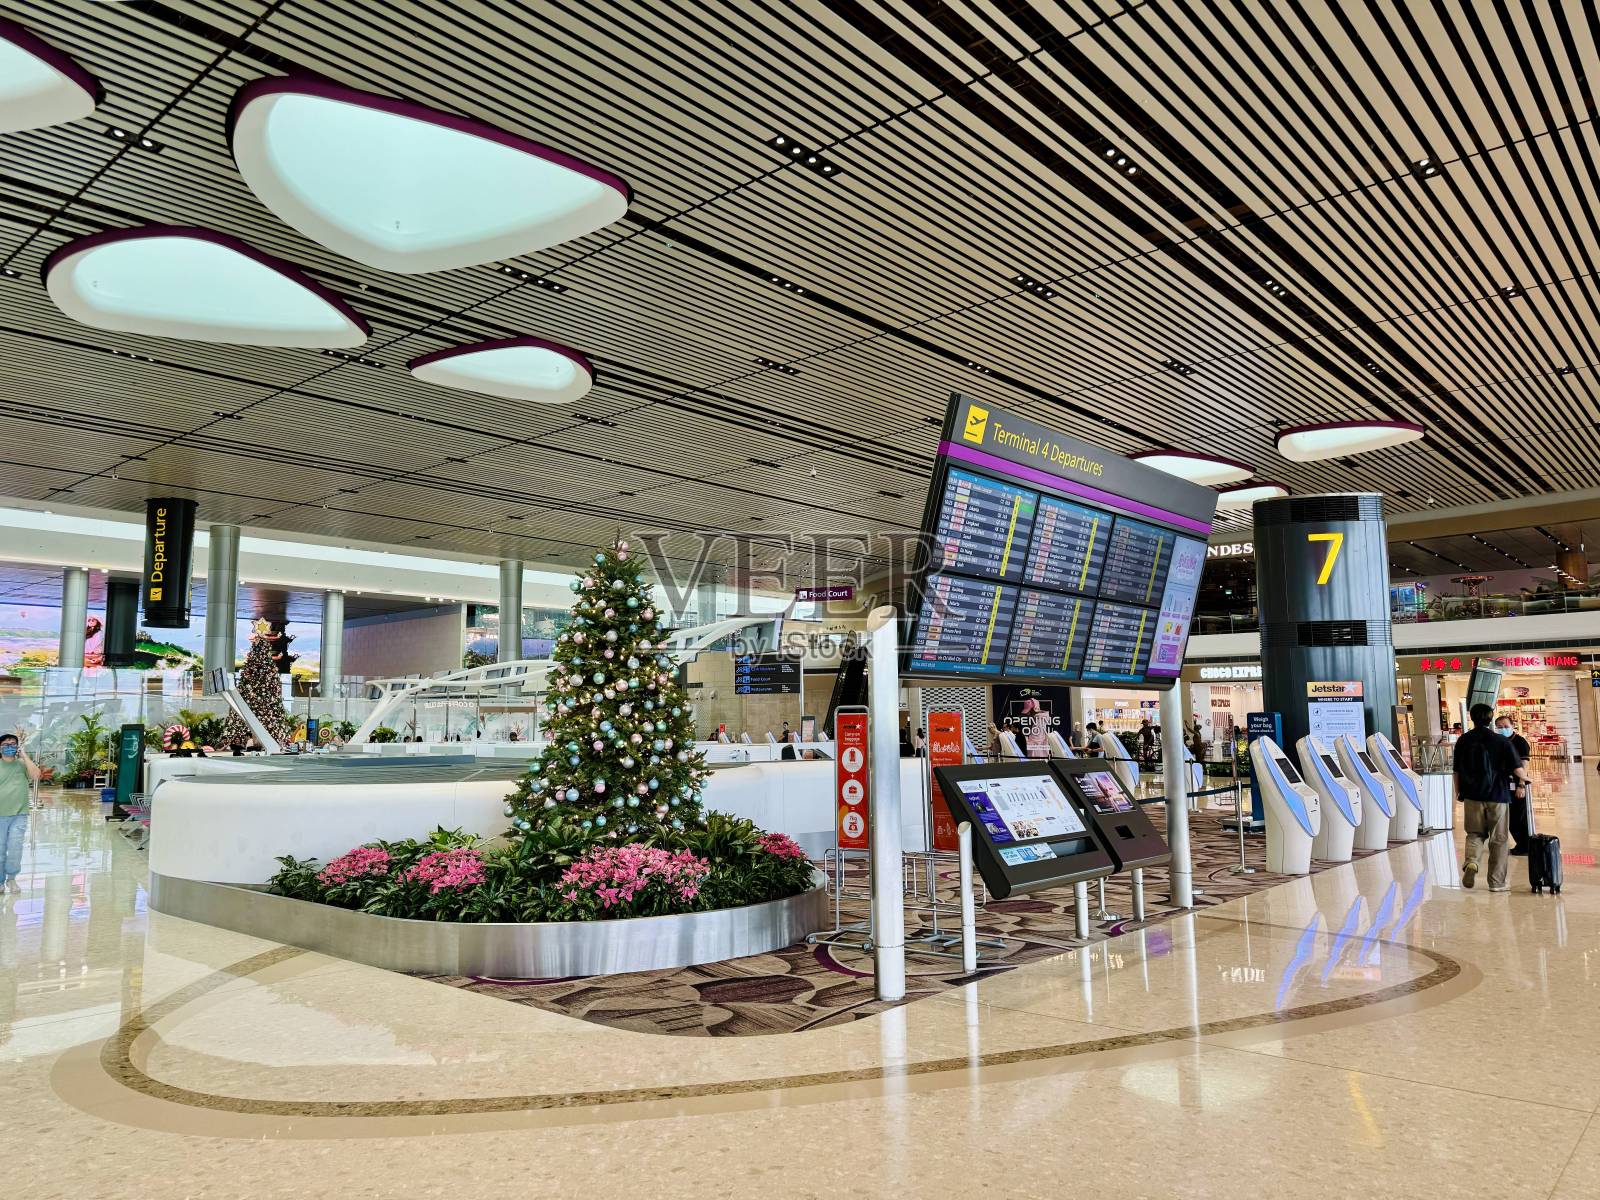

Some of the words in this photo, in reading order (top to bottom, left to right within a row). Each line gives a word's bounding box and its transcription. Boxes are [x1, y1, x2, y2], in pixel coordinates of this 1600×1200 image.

[993, 422, 1040, 456] Terminal
[1041, 442, 1049, 459] 4
[1050, 444, 1103, 477] Departures
[150, 507, 167, 582] Departure
[1207, 542, 1254, 557] NDES
[1307, 532, 1344, 585] 7
[809, 590, 827, 598] Food
[1544, 655, 1578, 666] HIANG
[1312, 684, 1346, 693] Jetstar
